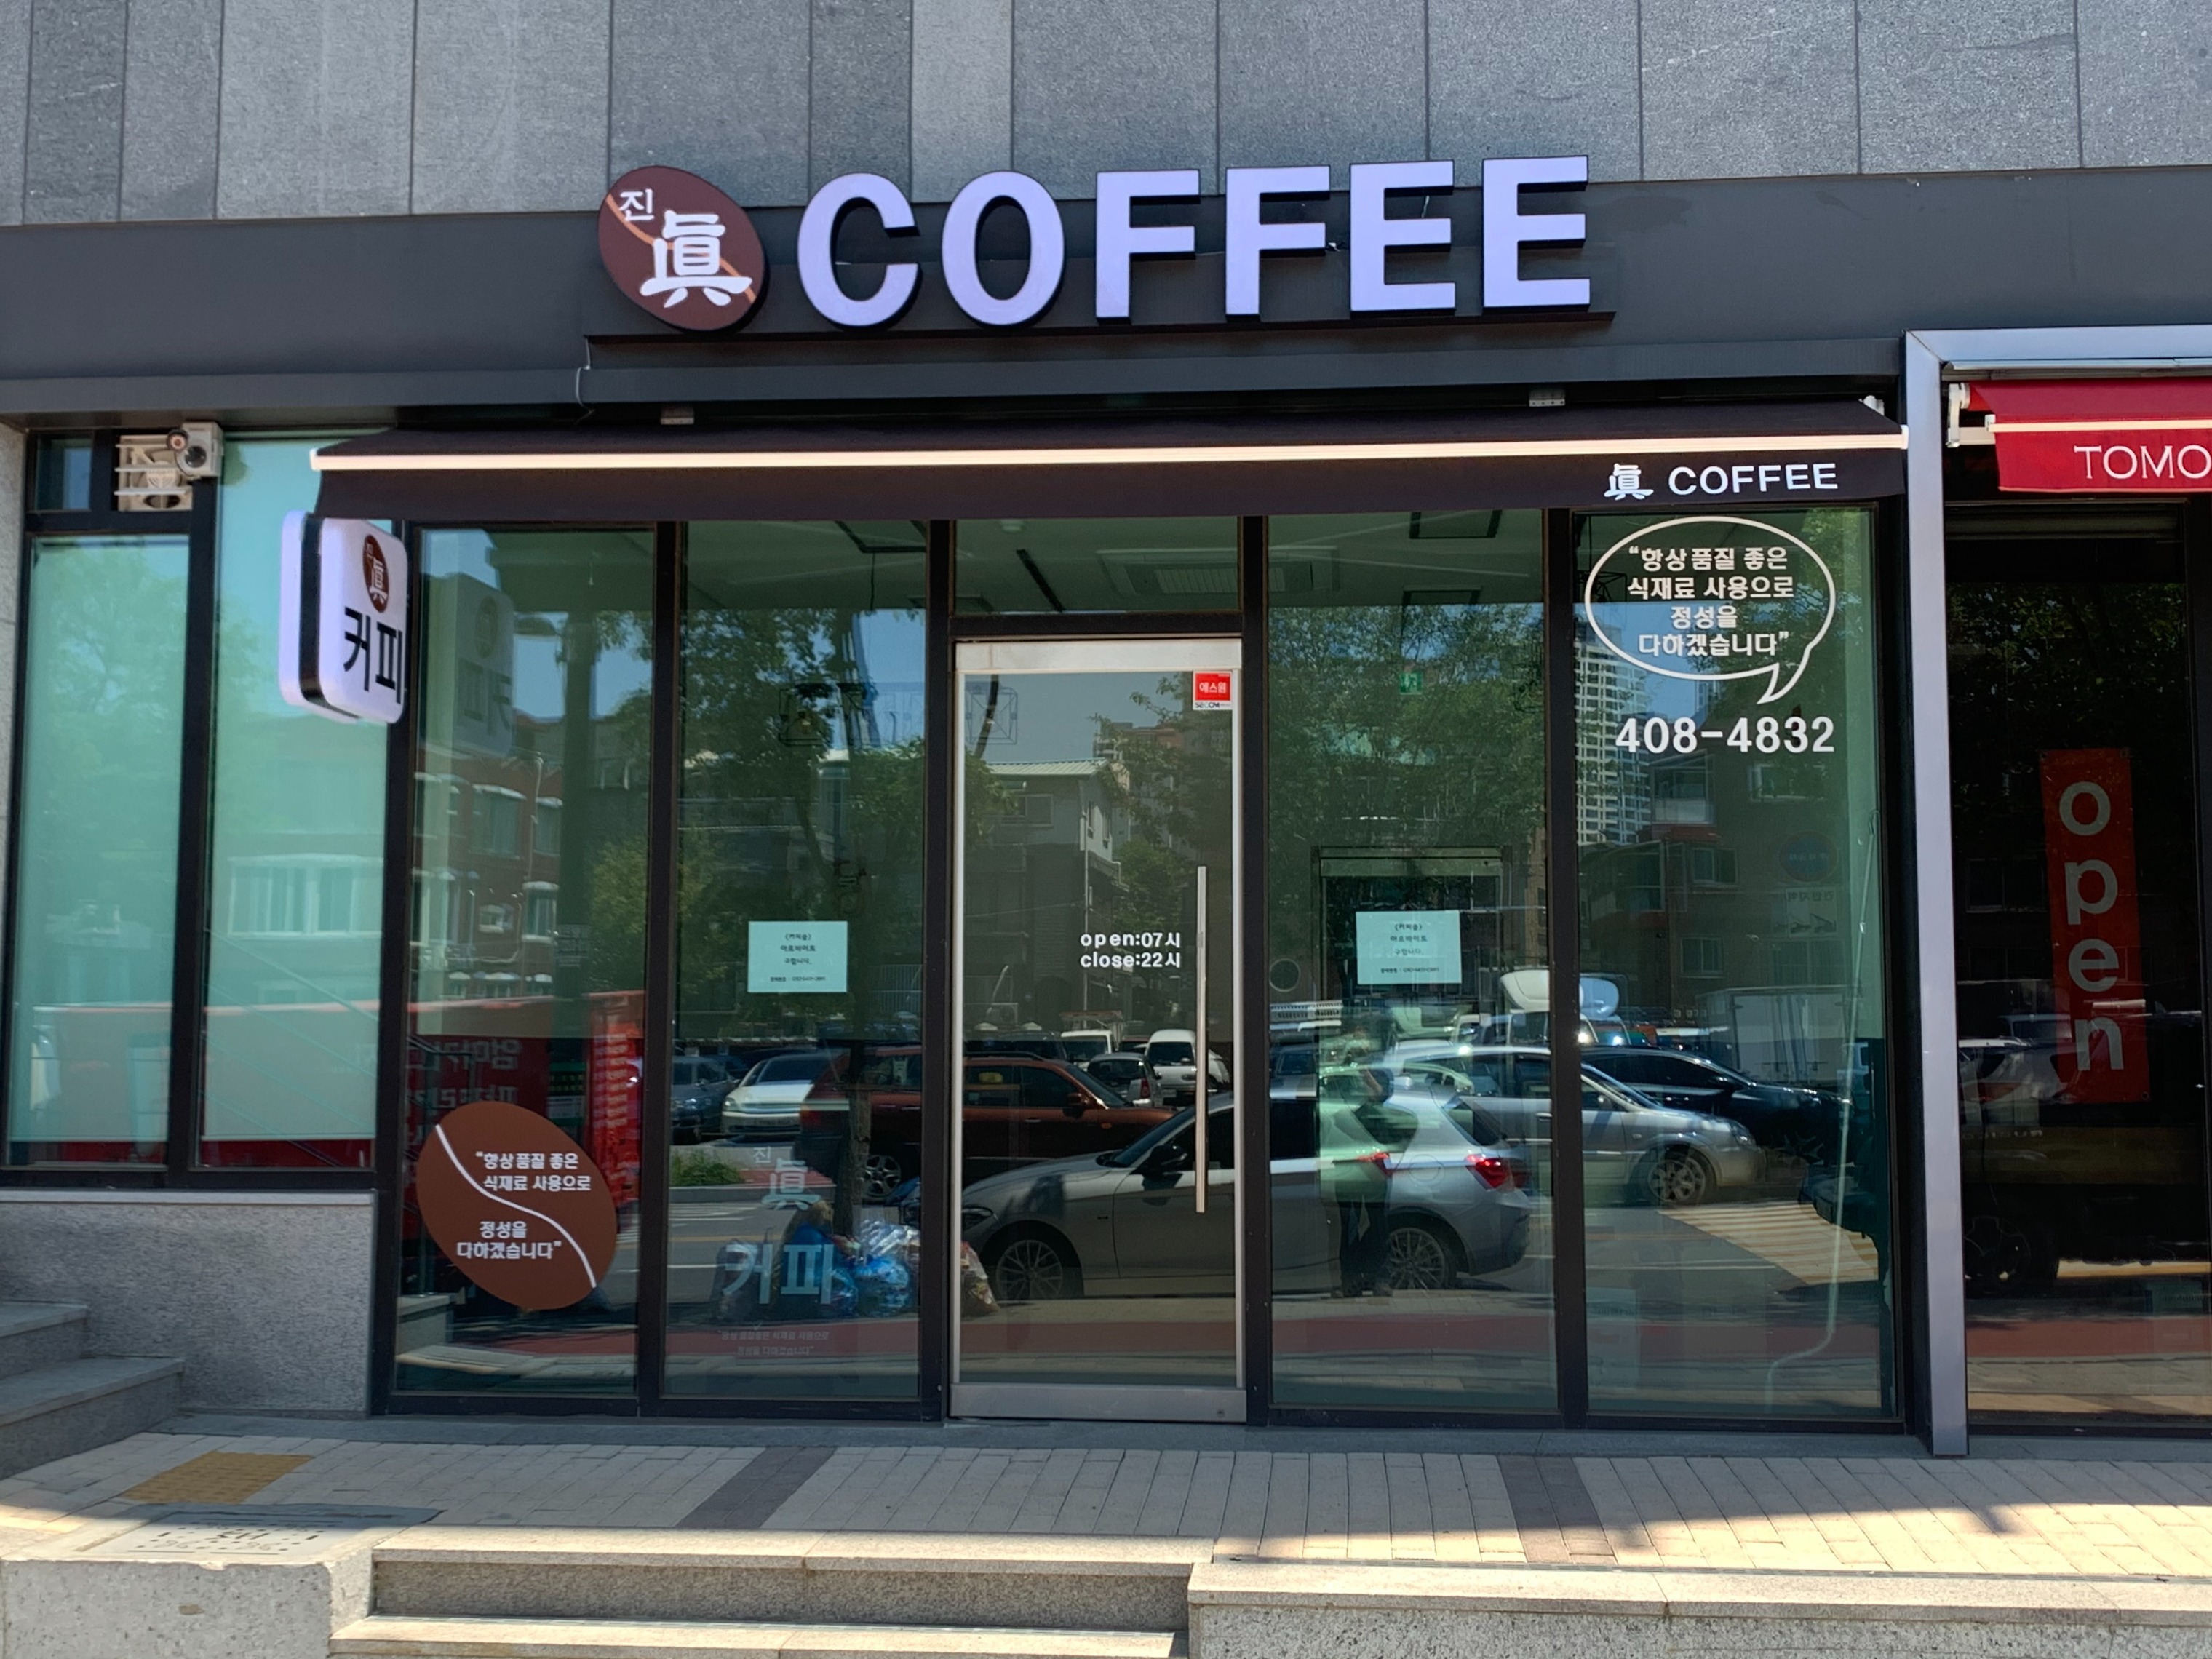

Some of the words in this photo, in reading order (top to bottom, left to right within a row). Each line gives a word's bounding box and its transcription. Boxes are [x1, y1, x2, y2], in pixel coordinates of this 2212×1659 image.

[618, 188, 655, 221] 진
[797, 155, 1591, 327] COFFEE
[2074, 445, 2212, 479] TOMO
[1668, 463, 1838, 496] COFFEE
[1743, 546, 1788, 571] 좋은
[1628, 576, 1695, 600] 식재료
[1703, 576, 1794, 600] 사용으로
[1671, 605, 1738, 629] 정성을
[343, 606, 403, 704] 커피
[1615, 716, 1834, 754] 408-4832
[2059, 781, 2125, 1071] open
[549, 1153, 579, 1170] 좋은
[752, 1147, 772, 1164] 진
[483, 1174, 528, 1192] 식재료
[532, 1174, 592, 1192] 사용으로
[479, 1220, 528, 1238] 정성을
[723, 1243, 834, 1305] 커피
